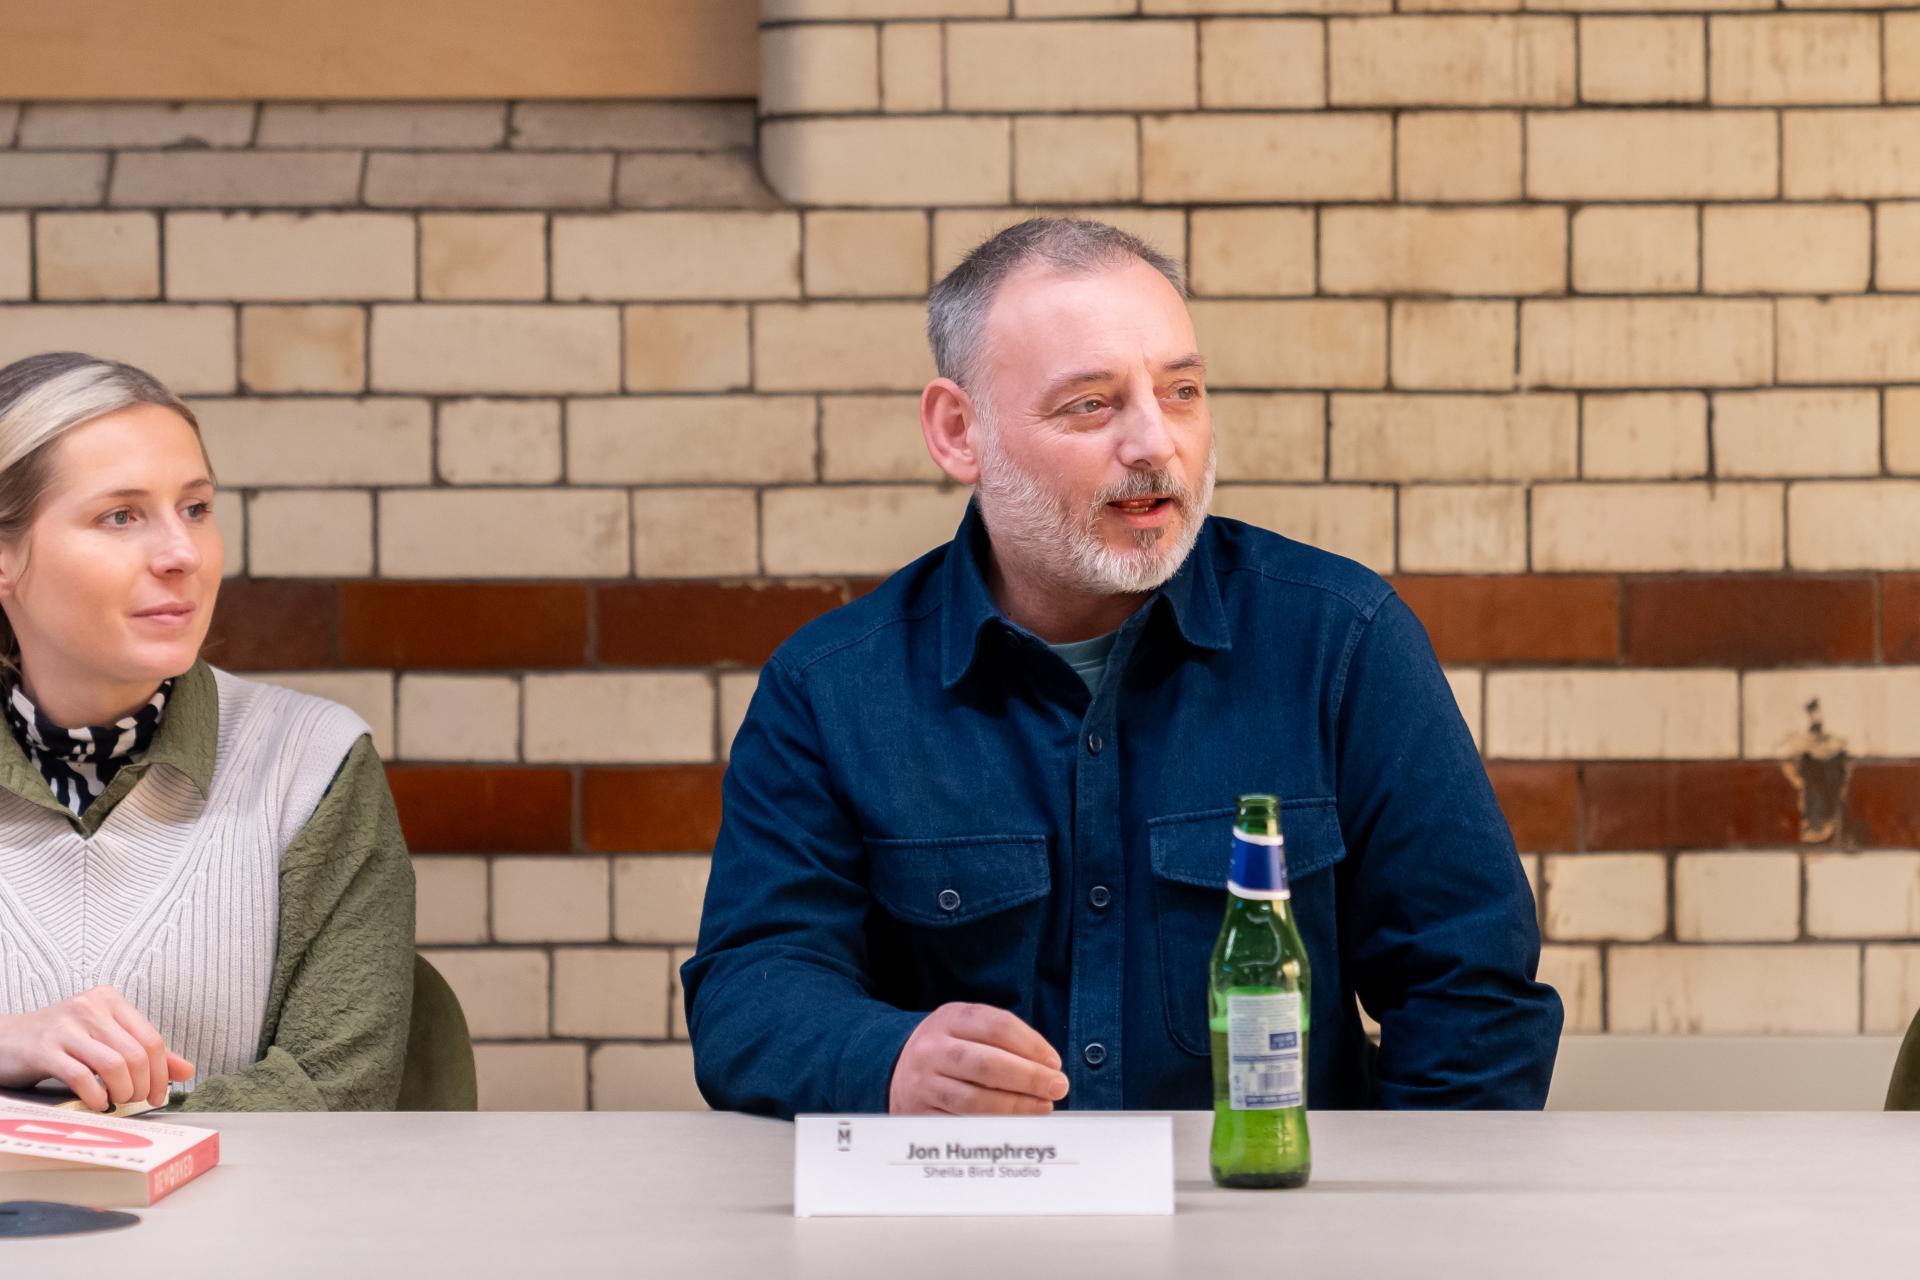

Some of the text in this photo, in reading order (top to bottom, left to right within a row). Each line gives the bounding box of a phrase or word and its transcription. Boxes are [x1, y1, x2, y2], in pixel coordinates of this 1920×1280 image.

[906, 1143, 1057, 1163] Jon Humphreys
[153, 1154, 193, 1194] REWORKED
[923, 1166, 1042, 1178] Sheila Bird Studio
